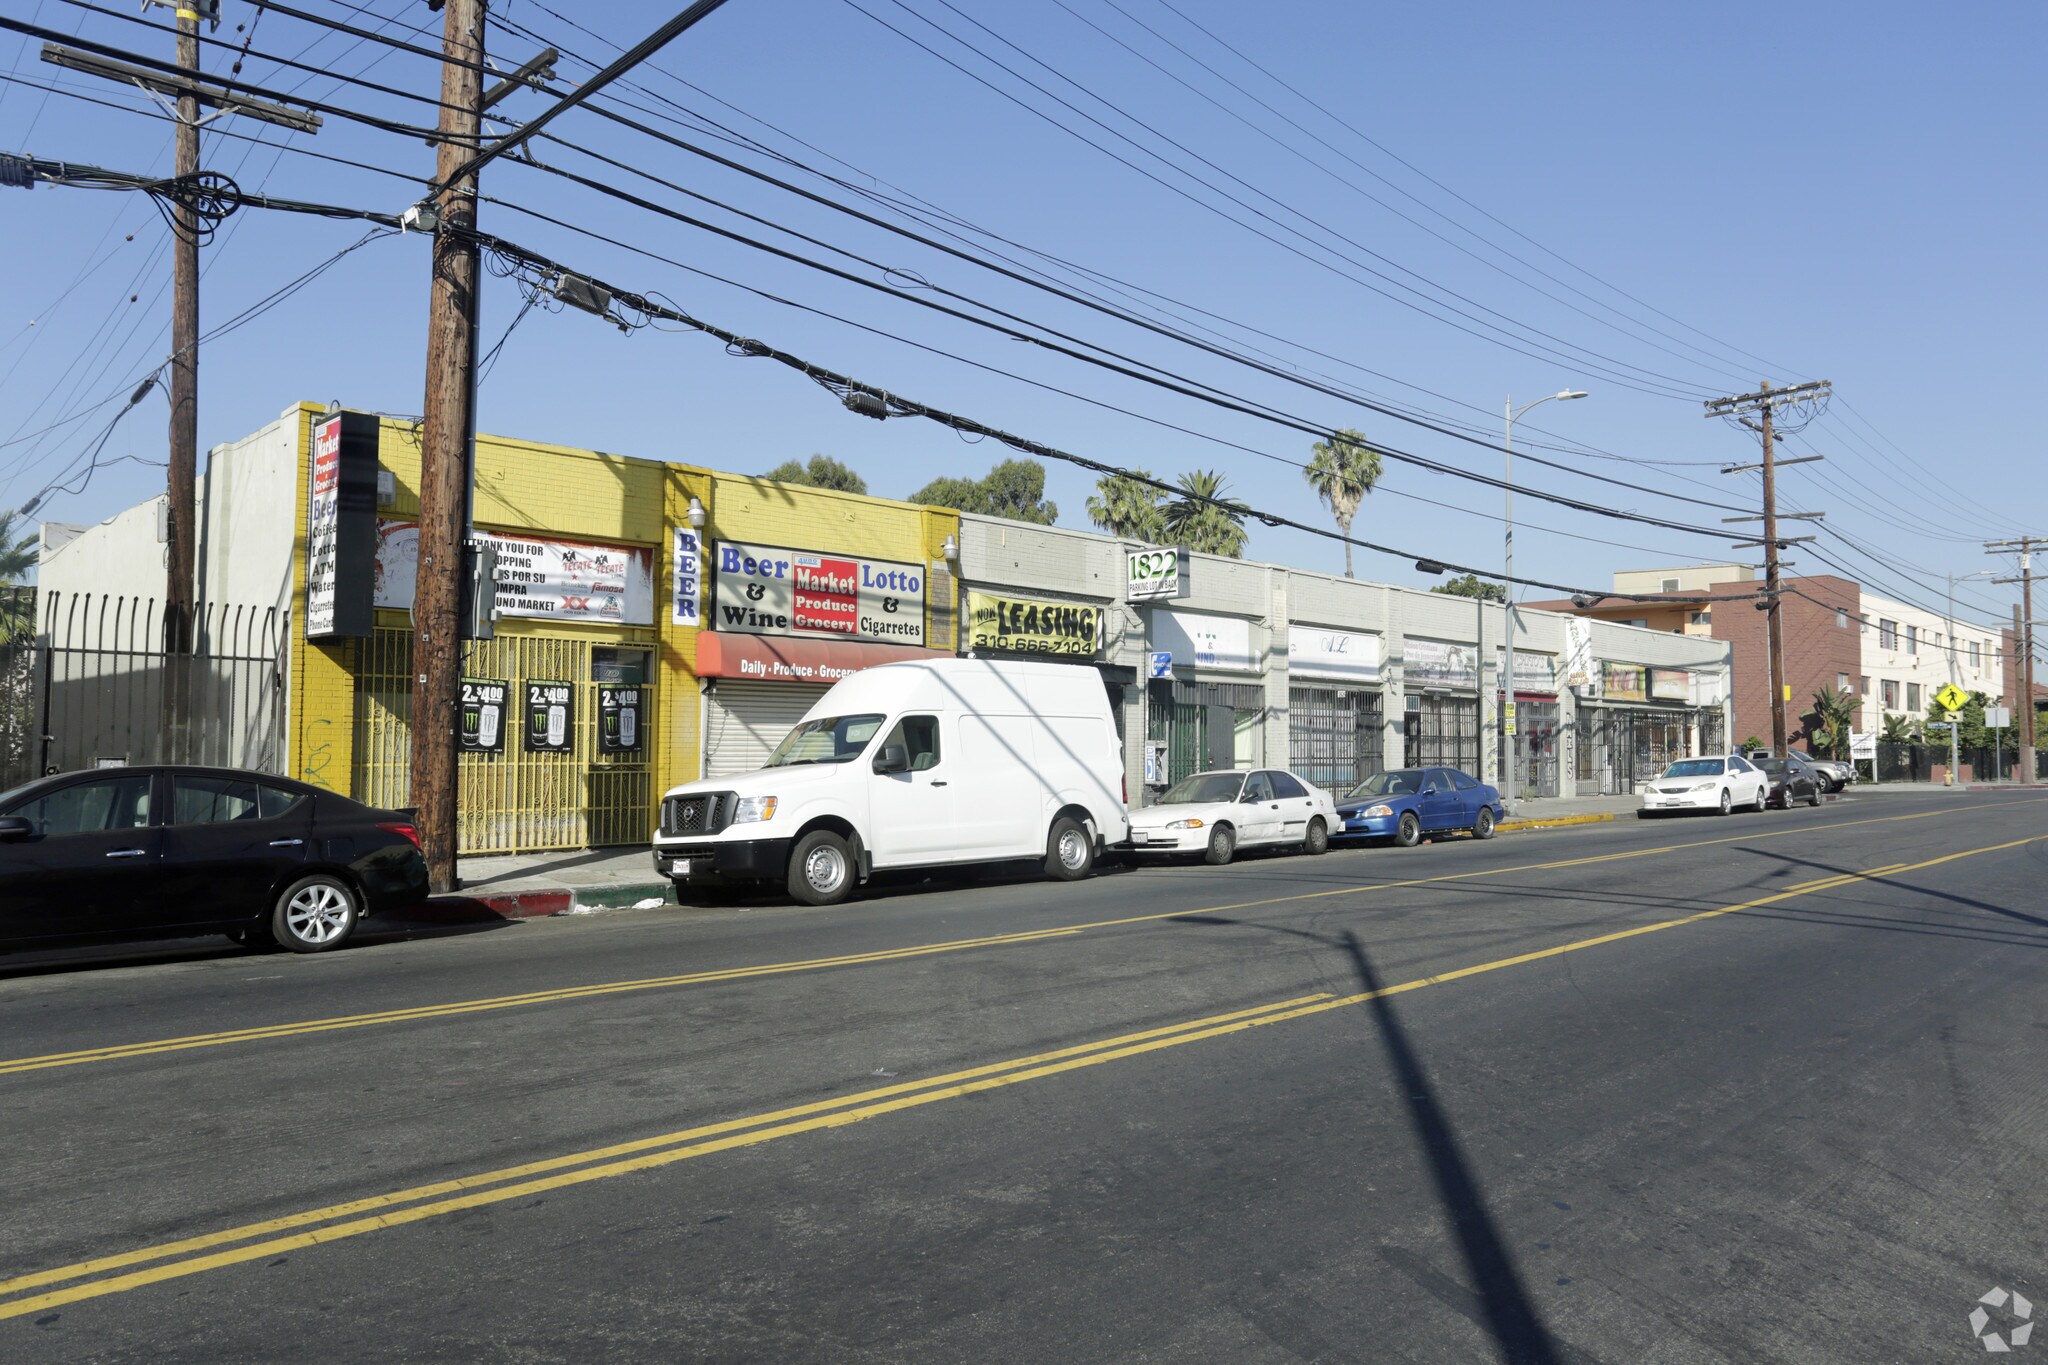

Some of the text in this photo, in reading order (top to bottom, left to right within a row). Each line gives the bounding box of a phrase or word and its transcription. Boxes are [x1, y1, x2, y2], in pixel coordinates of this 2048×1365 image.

[317, 433, 339, 459] Market
[315, 477, 338, 492] Grocery
[313, 499, 337, 521] Beer
[313, 523, 337, 539] Coffee
[312, 543, 336, 557] Lotto
[505, 542, 524, 553] YOU
[526, 545, 543, 556] FOR
[312, 560, 334, 577] ATM
[563, 559, 592, 571] TECATE
[596, 563, 624, 574] TECATE
[721, 547, 789, 579] Beer
[1130, 550, 1177, 581] 1822
[512, 570, 531, 582] POR
[533, 572, 546, 583] SU
[677, 533, 697, 618] BEER
[796, 567, 855, 595] Market
[862, 564, 920, 593] Lotto
[311, 581, 335, 597] Water
[746, 583, 766, 601] &
[1129, 582, 1149, 592] PARKING
[517, 599, 555, 611] MARKET
[795, 595, 855, 613] Produce
[882, 597, 899, 613] &
[309, 619, 322, 630] Phone
[722, 605, 787, 628] Wine
[795, 614, 855, 633] Grocery
[977, 600, 1095, 641] NOW LEASING
[861, 616, 920, 636] Cigarretes
[975, 634, 1092, 655] 310-666-7104
[741, 659, 767, 677] Daily
[773, 661, 813, 677] Produce
[462, 684, 472, 702] 2
[530, 686, 540, 703] 2
[602, 690, 611, 706] 2
